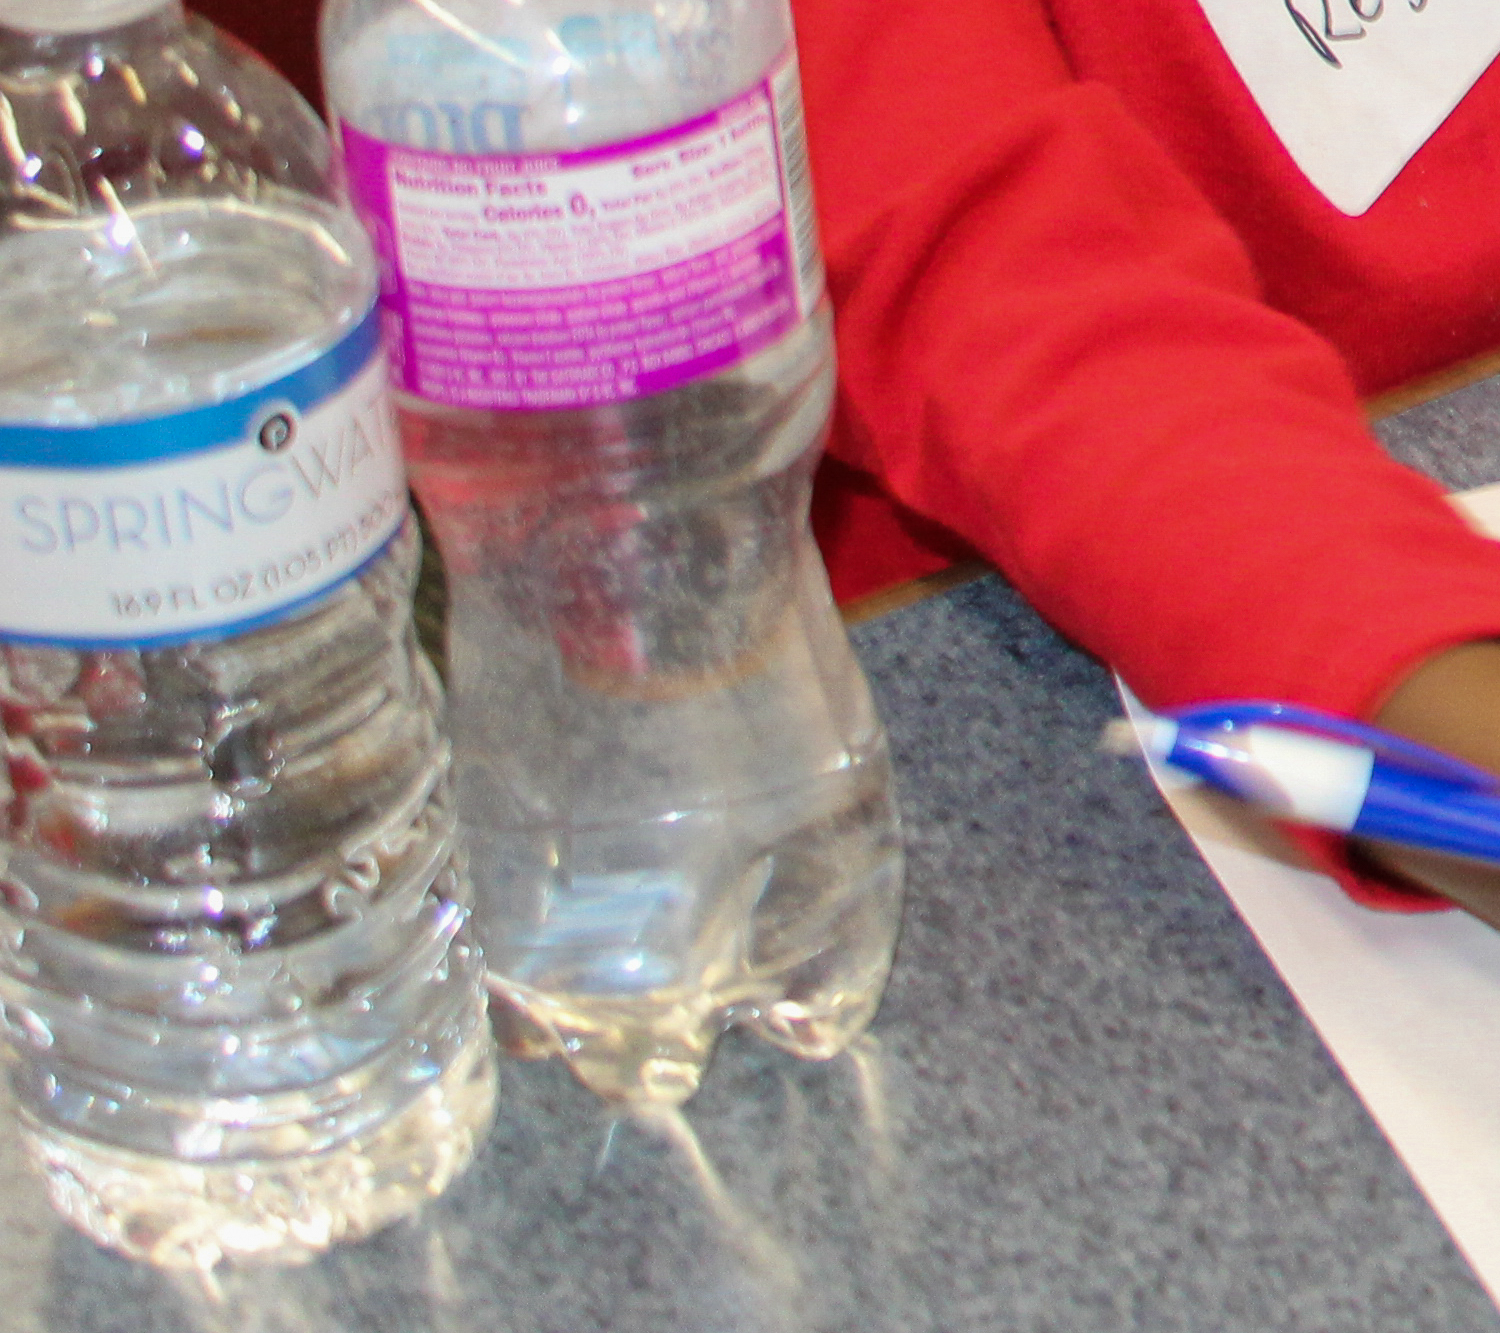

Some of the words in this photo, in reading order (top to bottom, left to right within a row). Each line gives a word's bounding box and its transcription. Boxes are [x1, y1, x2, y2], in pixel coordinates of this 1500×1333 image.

[394, 169, 478, 197] Nutrition
[483, 179, 546, 197] Facts
[483, 204, 563, 223] Calories
[168, 585, 201, 612] FL
[213, 572, 257, 604] OZ
